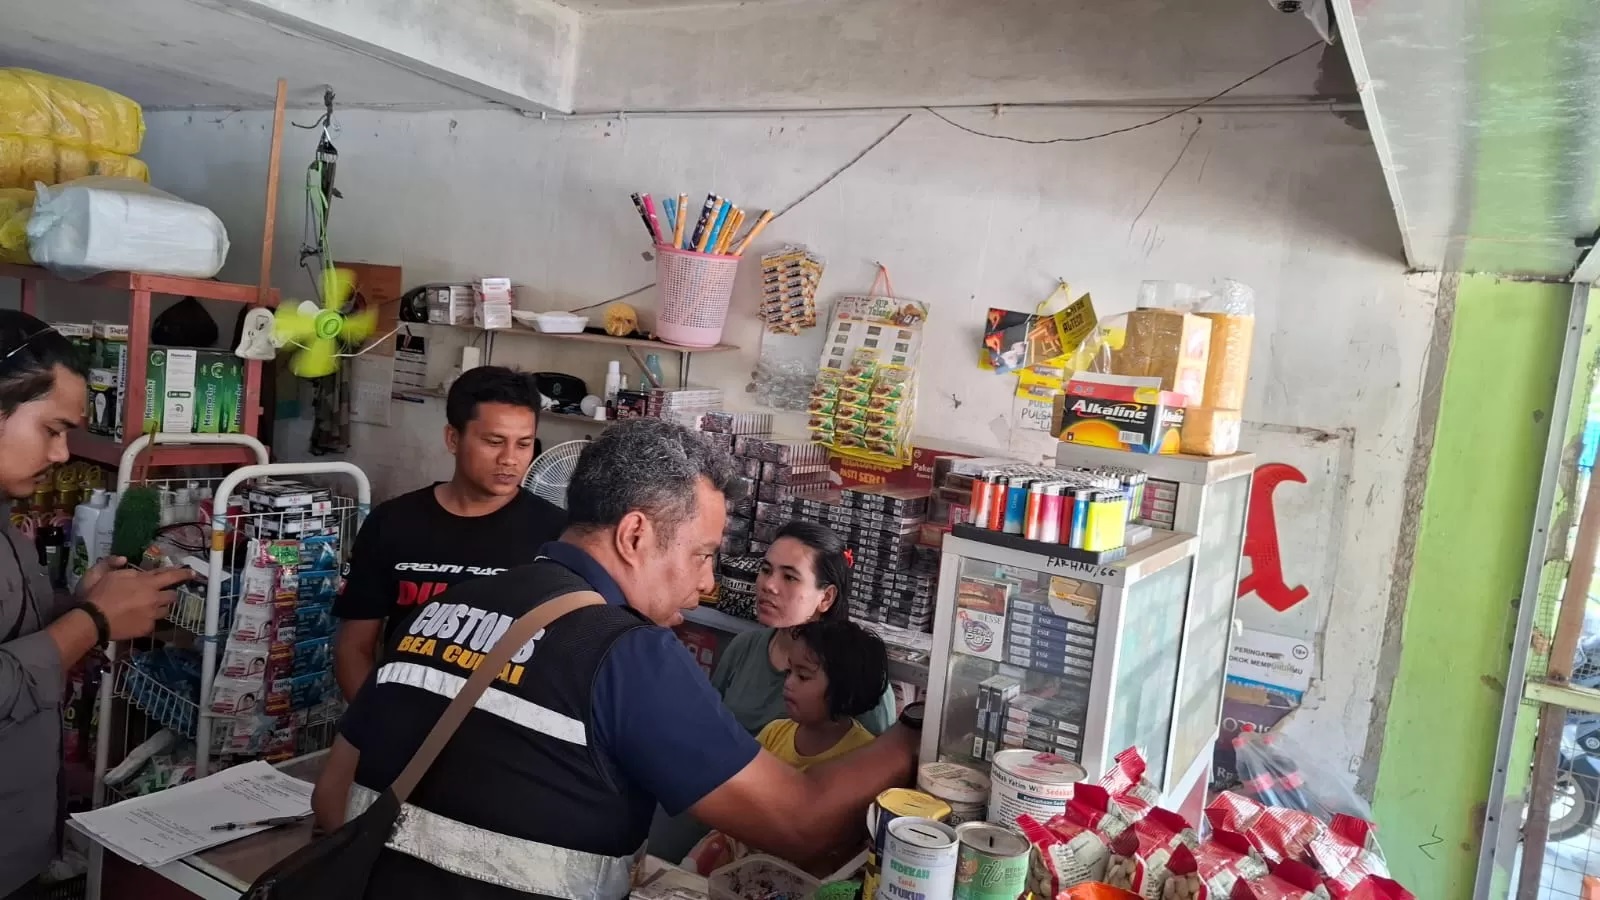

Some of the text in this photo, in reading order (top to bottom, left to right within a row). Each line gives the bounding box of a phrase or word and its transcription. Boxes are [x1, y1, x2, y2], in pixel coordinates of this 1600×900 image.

[1071, 399, 1148, 420] Alkaline
[394, 562, 464, 575] GRESINI
[396, 635, 526, 685] BEA CUAI
